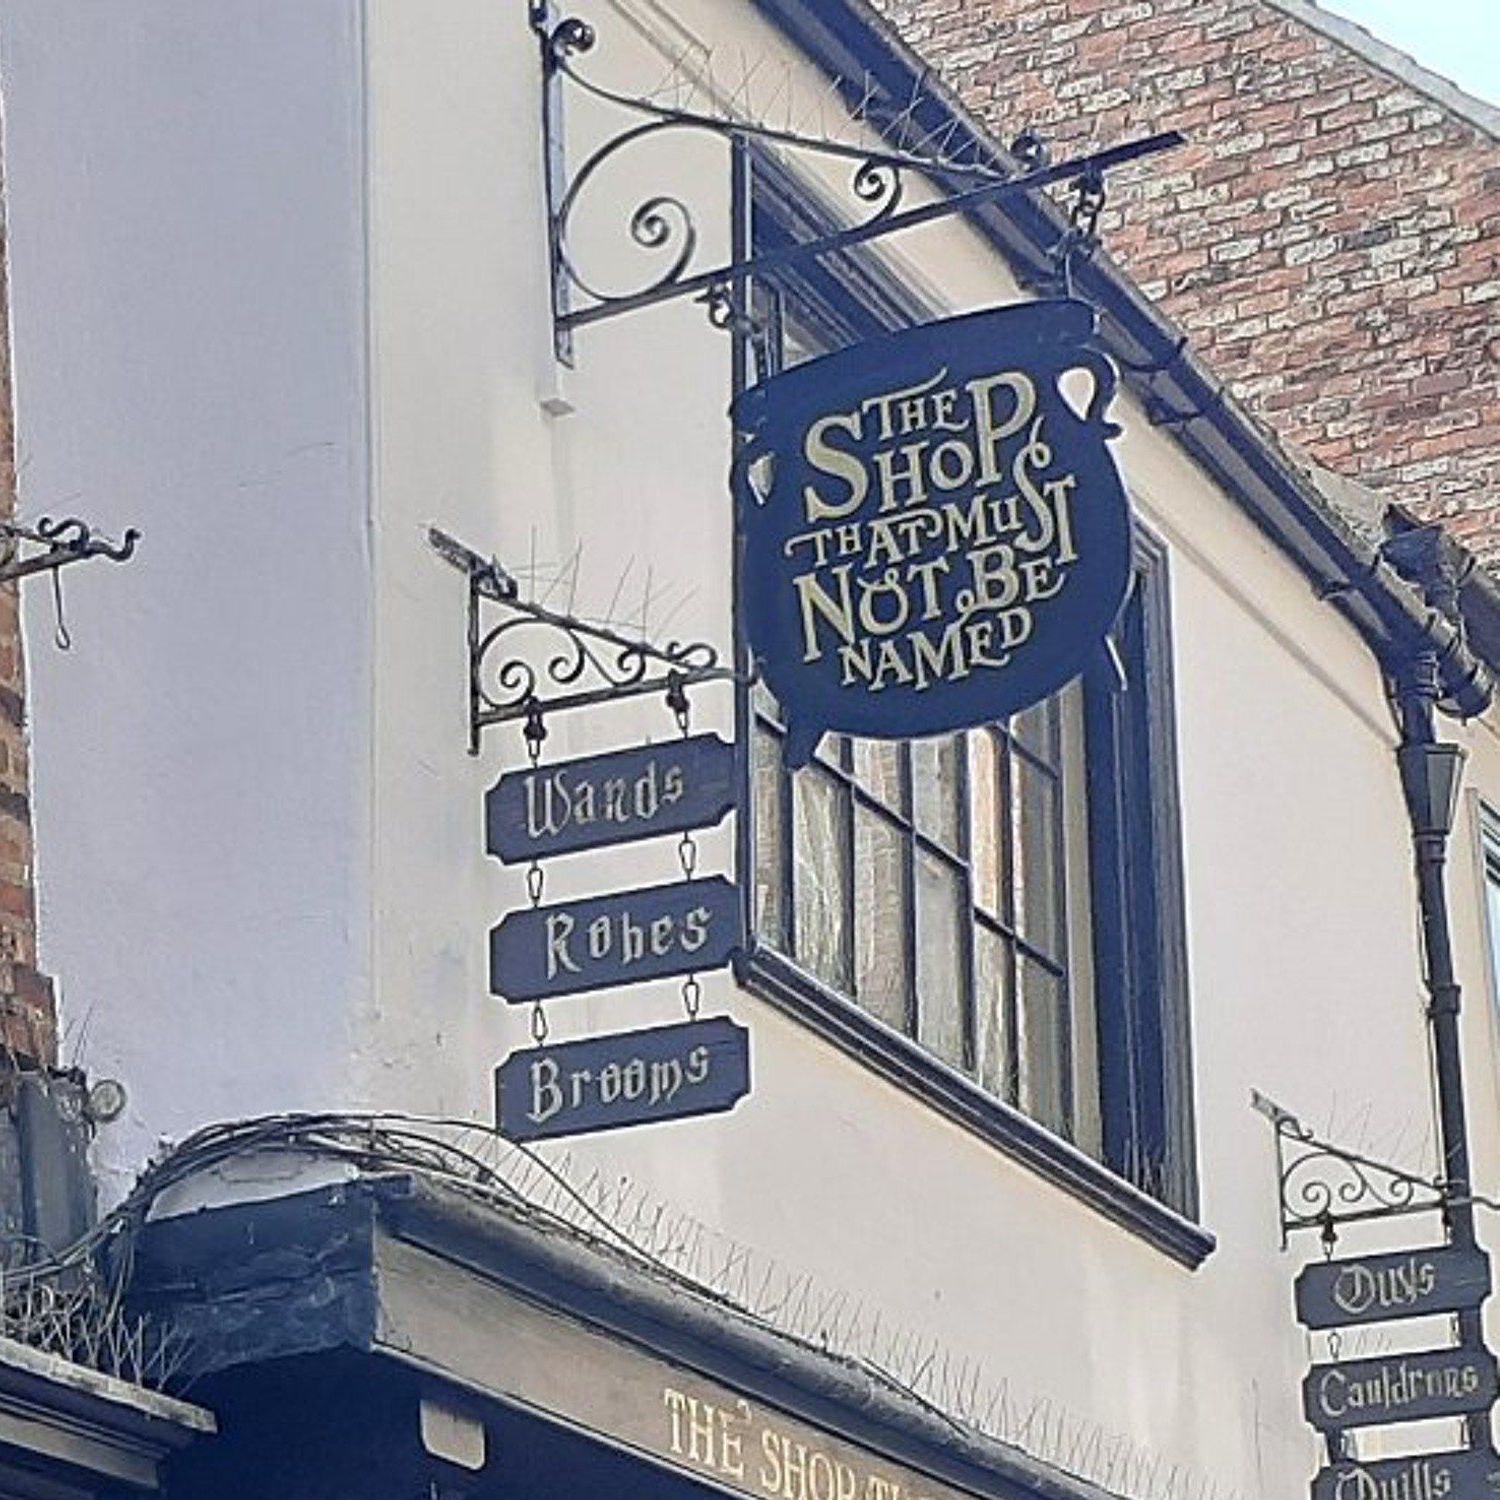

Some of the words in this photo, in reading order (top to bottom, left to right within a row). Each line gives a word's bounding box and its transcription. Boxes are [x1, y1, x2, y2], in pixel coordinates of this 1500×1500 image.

[863, 367, 970, 440] THE
[804, 371, 1037, 524] SHOP
[784, 509, 941, 569] THAT
[793, 557, 950, 663] NOT
[955, 545, 1066, 615] BE
[837, 604, 1033, 692] NAMED
[522, 760, 686, 840] Wands
[545, 905, 712, 982] Robes
[526, 1045, 710, 1123] Brooms
[1320, 1360, 1480, 1418] Cauldrons
[663, 1387, 747, 1480] THE
